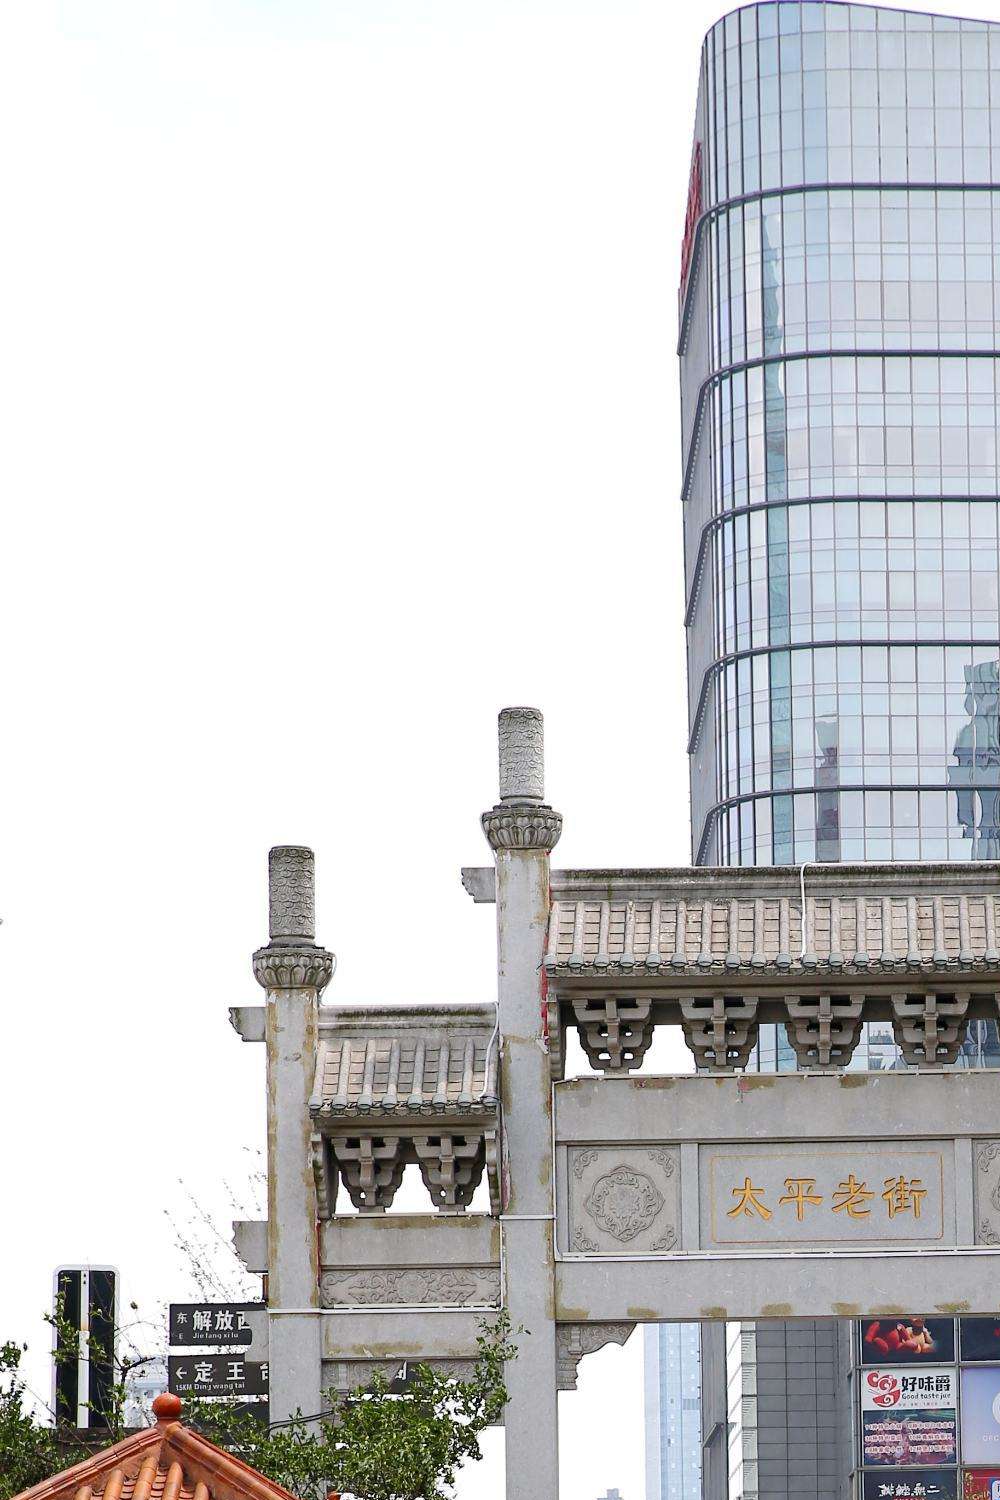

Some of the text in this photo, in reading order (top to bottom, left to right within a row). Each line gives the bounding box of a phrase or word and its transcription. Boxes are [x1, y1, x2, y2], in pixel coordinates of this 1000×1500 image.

[726, 1174, 929, 1222] 太平老街
[177, 1312, 188, 1324] 东
[901, 1392, 919, 1400] Good
